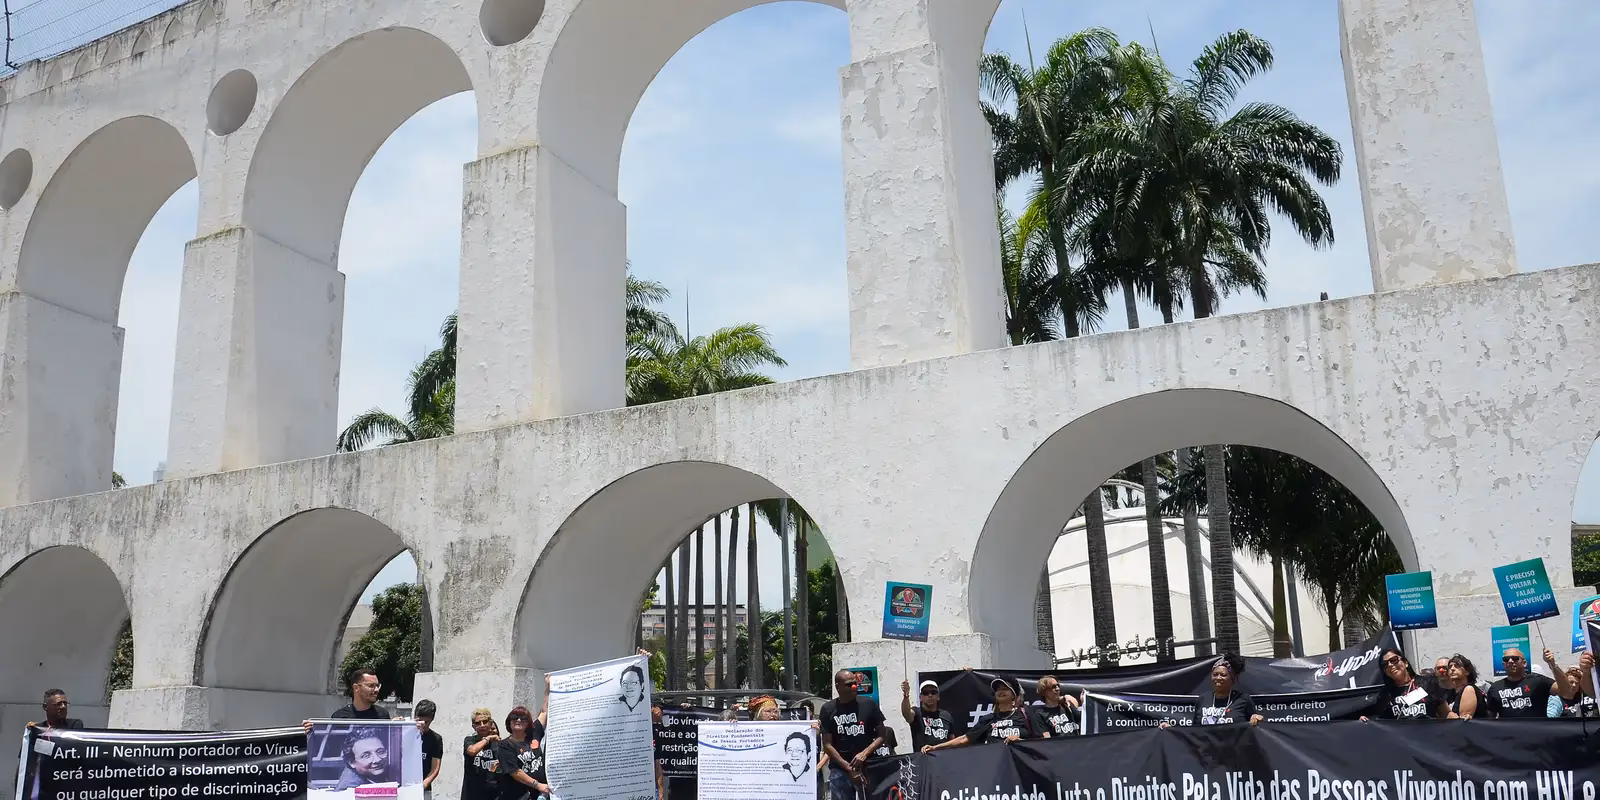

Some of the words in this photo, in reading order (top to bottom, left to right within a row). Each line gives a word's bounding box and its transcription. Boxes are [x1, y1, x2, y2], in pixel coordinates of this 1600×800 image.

[1510, 569, 1535, 580] PRECISO
[1509, 579, 1532, 590] VOLTAR
[1516, 587, 1535, 597] FALAR
[1507, 601, 1516, 609] DE
[1516, 593, 1551, 607] PREVENÇÃO
[1070, 633, 1177, 668] voador
[1498, 687, 1522, 698] VIVA
[1106, 703, 1126, 712] Art.
[1127, 703, 1135, 712] X
[1144, 703, 1169, 713] Todo
[1266, 702, 1287, 711] tem
[1290, 700, 1326, 710] direito
[1502, 698, 1510, 708] A
[1510, 697, 1532, 710] VIDA
[1401, 703, 1427, 717] VIDA
[669, 716, 679, 725] do
[834, 712, 858, 725] VIVA
[1106, 717, 1113, 727] à
[1179, 717, 1193, 727] de
[837, 725, 845, 735] A
[844, 724, 865, 737] VIDA
[925, 726, 932, 736] A
[991, 727, 999, 737] A
[1055, 724, 1061, 734] A
[677, 731, 684, 739] e
[685, 731, 697, 739] ao
[54, 746, 81, 760] Art.
[85, 746, 99, 759] III
[113, 745, 175, 758] Nenhum
[179, 743, 240, 760] portador
[243, 743, 262, 756] do
[265, 742, 299, 756] Vírus
[661, 743, 698, 755] restrição
[473, 757, 481, 767] A
[52, 766, 83, 781] será
[87, 764, 166, 780] submetido
[169, 767, 178, 777] a
[181, 763, 262, 776] isolamento,
[56, 790, 75, 800] ou
[79, 786, 145, 800] qualquer
[148, 785, 177, 799] tipo
[181, 783, 199, 797] de
[203, 780, 298, 797] discriminação
[1182, 773, 1221, 800] Pela
[1226, 770, 1265, 800] Vida
[1270, 770, 1301, 800] das
[1307, 769, 1389, 800] Pessoas
[1393, 769, 1476, 800] Vivendo
[1483, 780, 1529, 800] com
[1535, 770, 1573, 800] HIV
[1582, 780, 1596, 800] e
